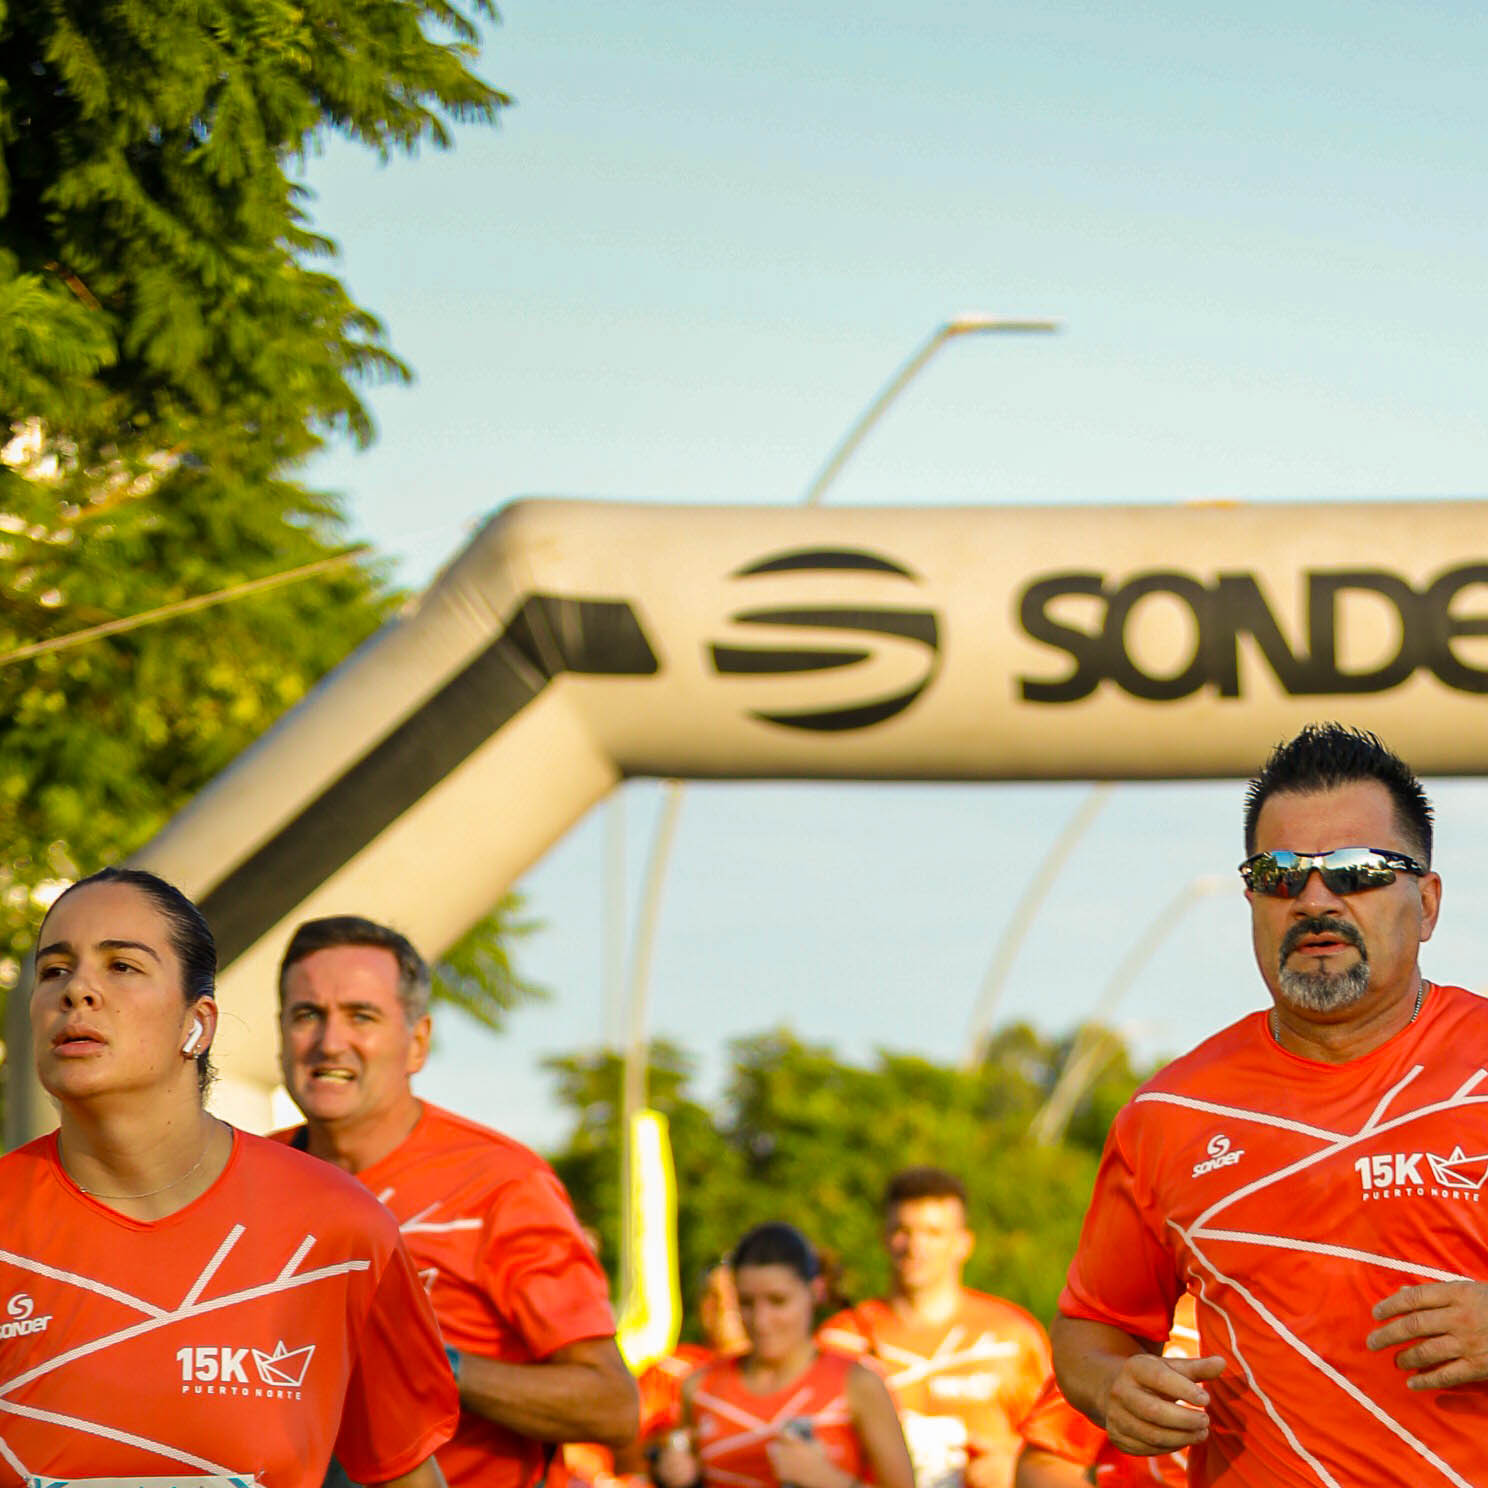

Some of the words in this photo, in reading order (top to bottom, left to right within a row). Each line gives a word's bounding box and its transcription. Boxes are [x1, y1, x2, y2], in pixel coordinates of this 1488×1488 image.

[1355, 1153, 1424, 1189] 15K
[1363, 1188, 1424, 1200] PUERTO
[1431, 1188, 1480, 1202] NORTE
[176, 1347, 249, 1383] 15K
[181, 1386, 249, 1396] PUERTO
[255, 1389, 302, 1400] NORTE
